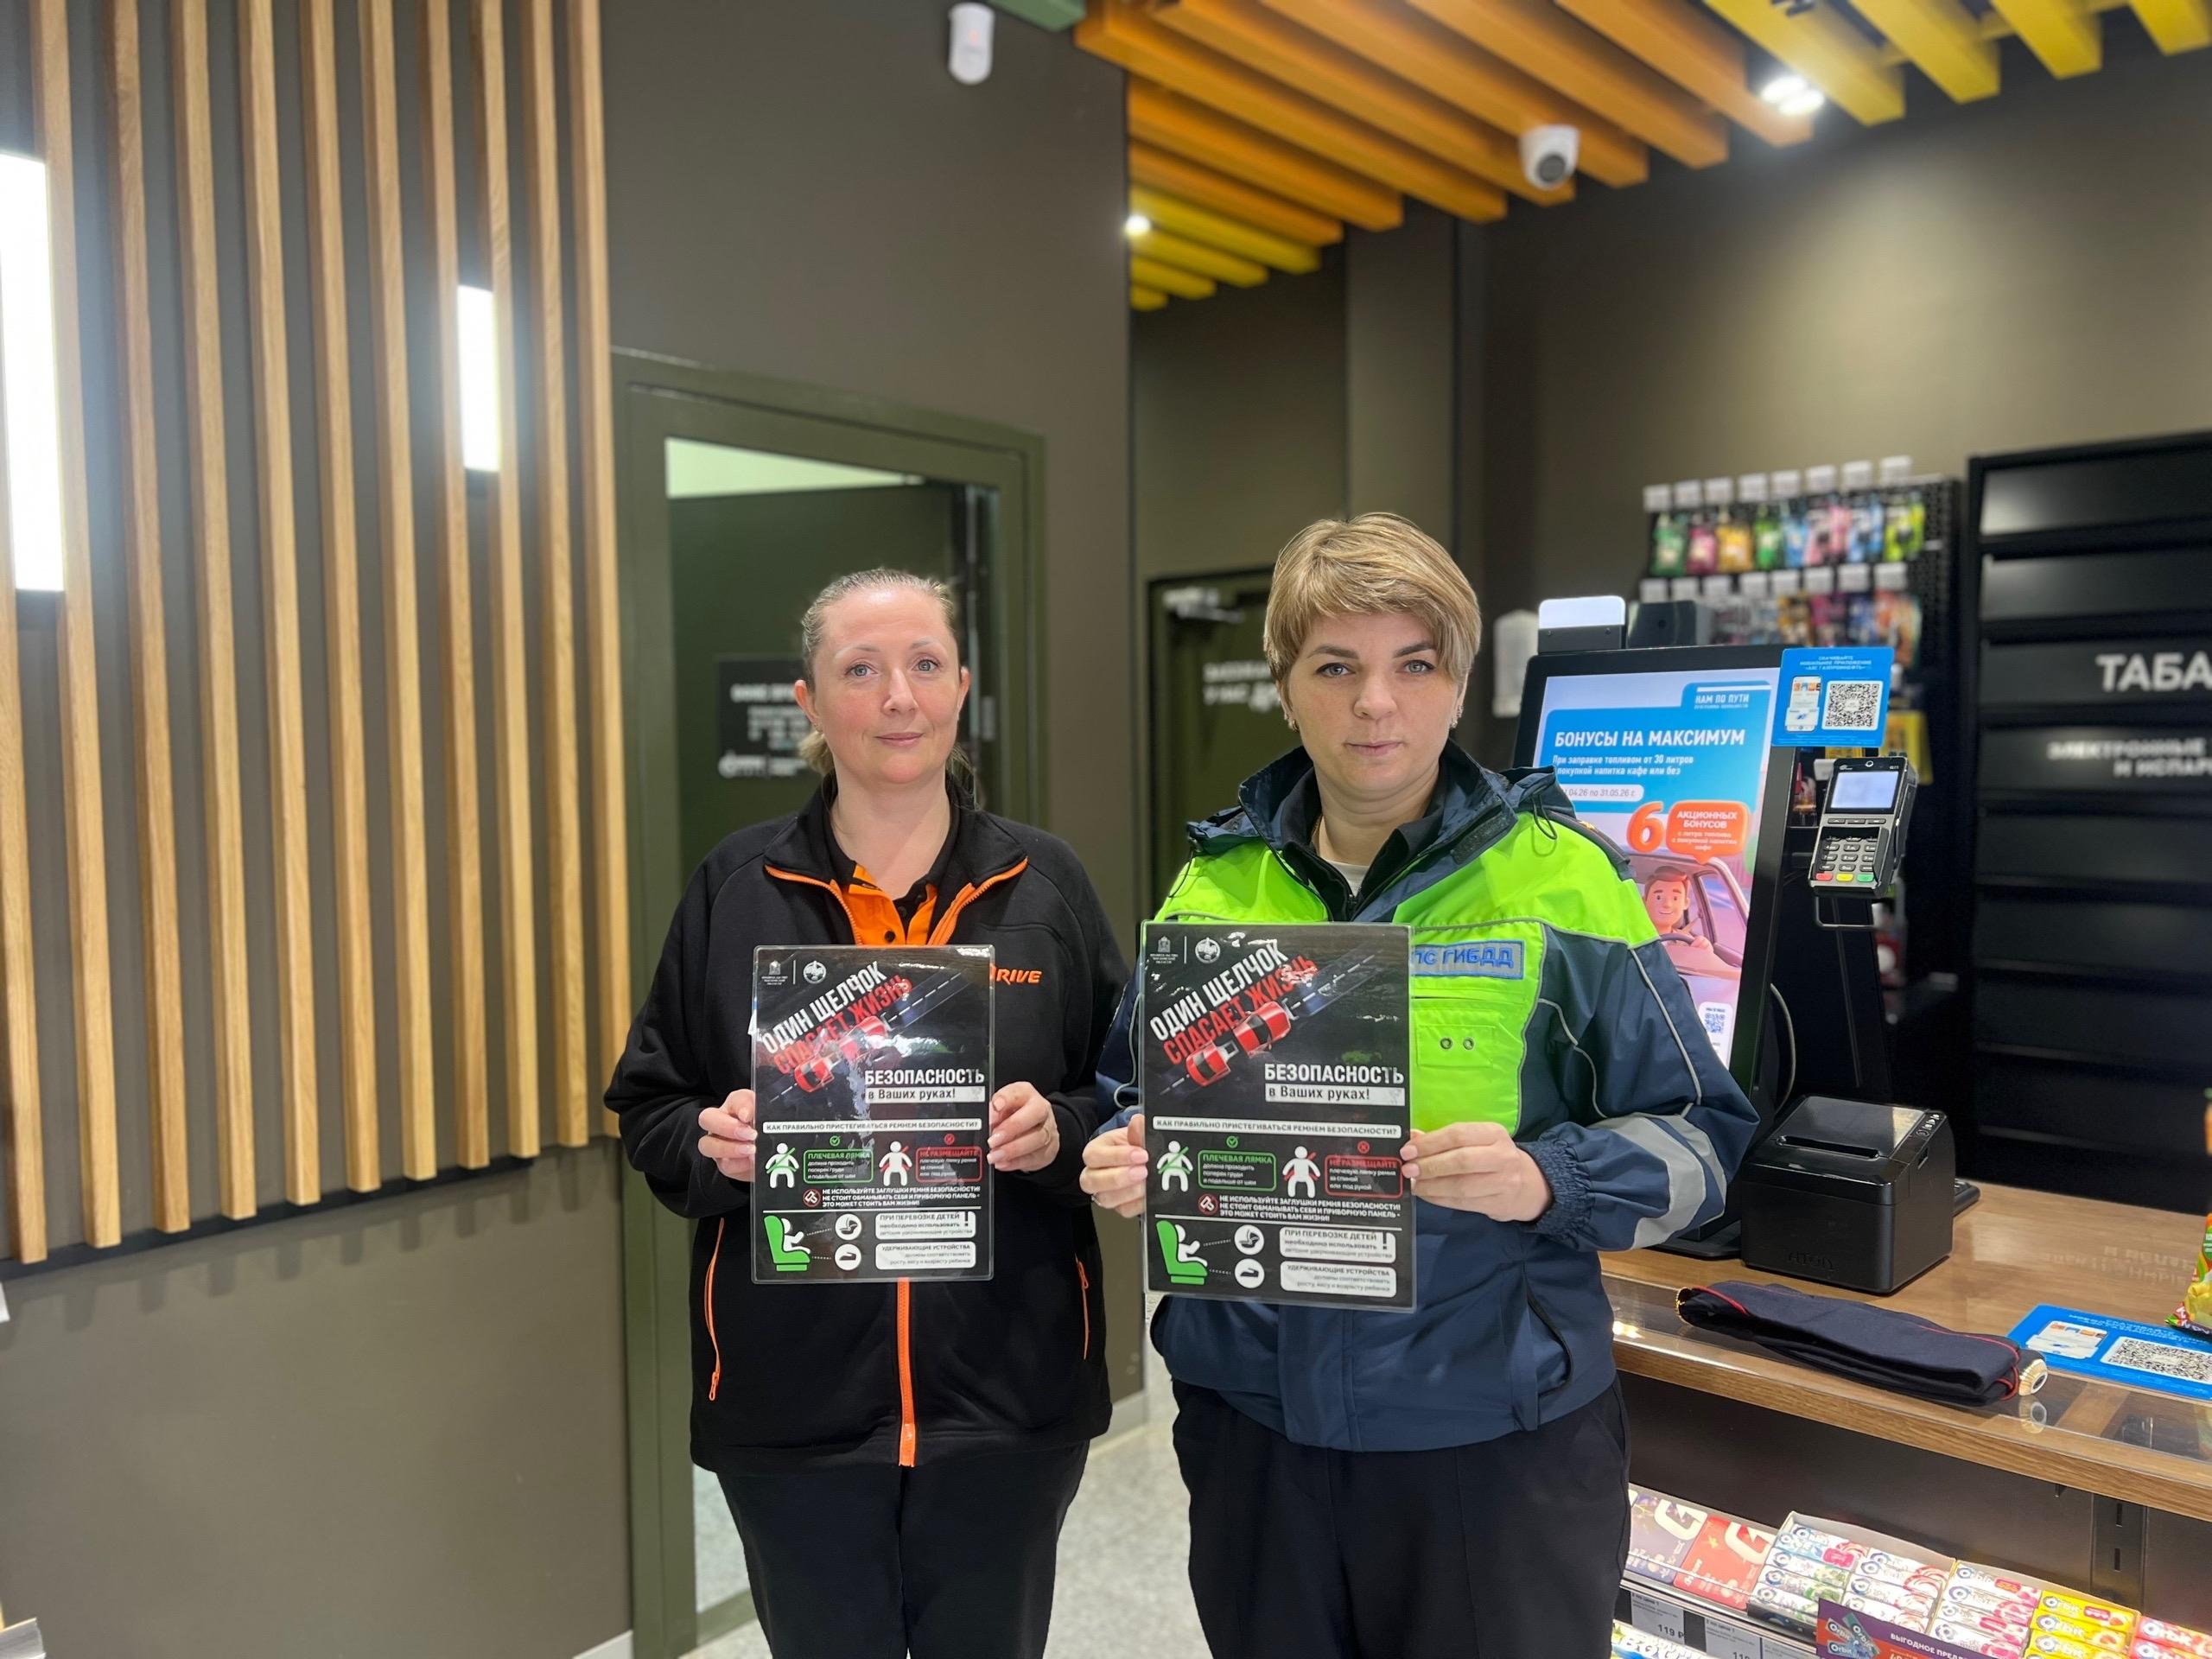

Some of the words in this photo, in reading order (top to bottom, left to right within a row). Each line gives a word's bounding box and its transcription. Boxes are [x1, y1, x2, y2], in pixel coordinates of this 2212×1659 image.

[2094, 651, 2212, 691] ТАБА
[1695, 696, 1713, 704] НАМ
[1715, 695, 1726, 703] ПО
[1728, 694, 1749, 703] ПУТИ
[1554, 731, 1618, 747] БОНУСЫ
[1622, 730, 1643, 747] НА
[1648, 729, 1745, 747] МАКСИМУМ
[1553, 755, 1567, 766] При
[1568, 757, 1602, 766] заправке
[1654, 754, 1664, 764] 30
[1666, 755, 1694, 765] литров
[1557, 766, 1592, 777] покупкой
[1627, 766, 1647, 777] кафе
[1666, 766, 1681, 775] без
[1676, 811, 1738, 820] АКЦИОННЫХ
[1626, 801, 1664, 854] 6
[1683, 821, 1727, 830] БОНУСОВ
[1414, 950, 1437, 965] ПС
[1442, 947, 1514, 969] ГИБДД
[1150, 995, 1207, 1042] ОДИН
[1203, 942, 1288, 1007] ЩЕЛЧОК
[762, 1008, 814, 1053] ОДИН
[809, 961, 887, 1022] ЩЕЛЧОК
[1163, 995, 1253, 1065] СПАСАЕТ
[864, 1069, 985, 1085] БЕЗОПАСНОСТЬ
[1265, 1064, 1404, 1084] БЕЗОПАСНОСТЬ
[878, 1090, 916, 1099] Ваших
[919, 1090, 956, 1102] руках!
[1281, 1088, 1323, 1099] Ваших
[1327, 1090, 1370, 1101] руках!
[1203, 1154, 1243, 1163] ПЛЕЧЕВАЯ
[1230, 1196, 1279, 1205] ИСПОЛЬЗУЙТЕ
[1323, 1208, 1367, 1217] ПРИБОРНУЮ
[1302, 1230, 1348, 1239] ПЕРЕВОЗКЕ
[1350, 1231, 1376, 1241] ДЕТЕЙ
[1346, 1268, 1390, 1276] УСТРОЙСТВА
[1658, 1624, 1675, 1637] 119
[1890, 1633, 1936, 1653] ВЫГОДНОЕ
